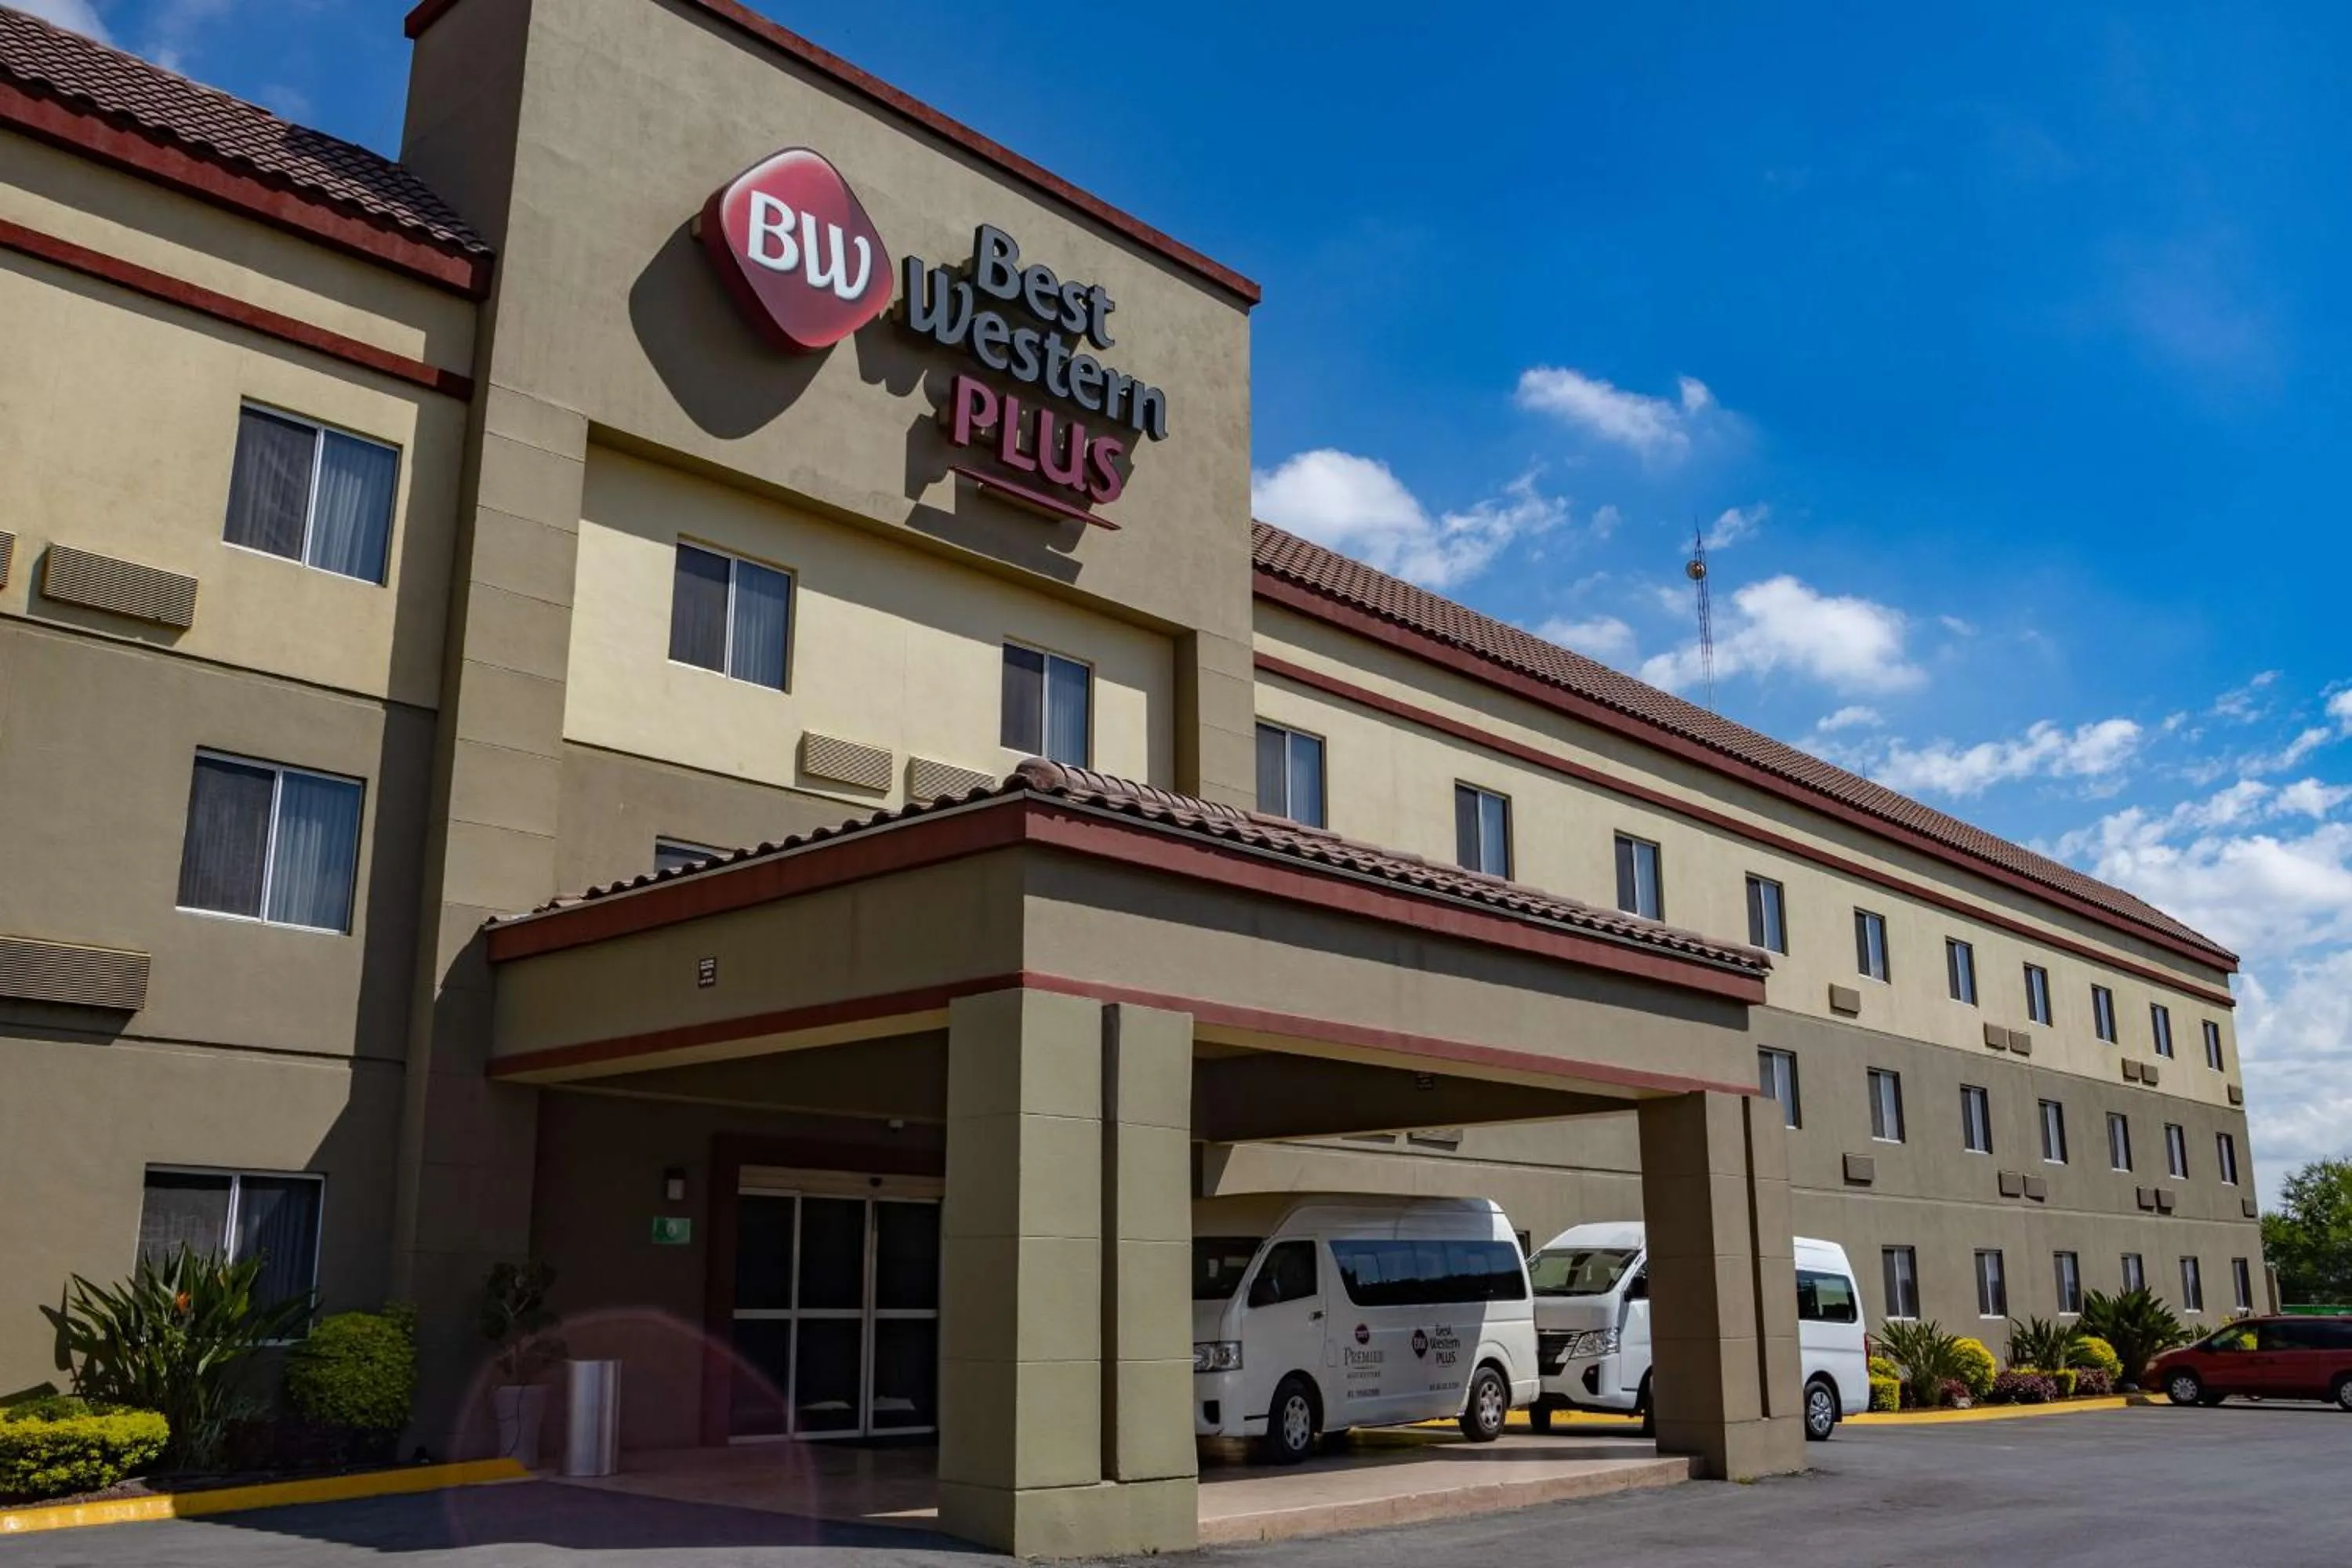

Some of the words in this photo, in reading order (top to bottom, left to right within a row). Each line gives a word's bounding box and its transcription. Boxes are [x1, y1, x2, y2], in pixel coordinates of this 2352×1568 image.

[748, 191, 871, 300] BW
[974, 223, 1116, 350] Best
[902, 255, 1169, 441] Western
[948, 376, 1124, 505] PLUS
